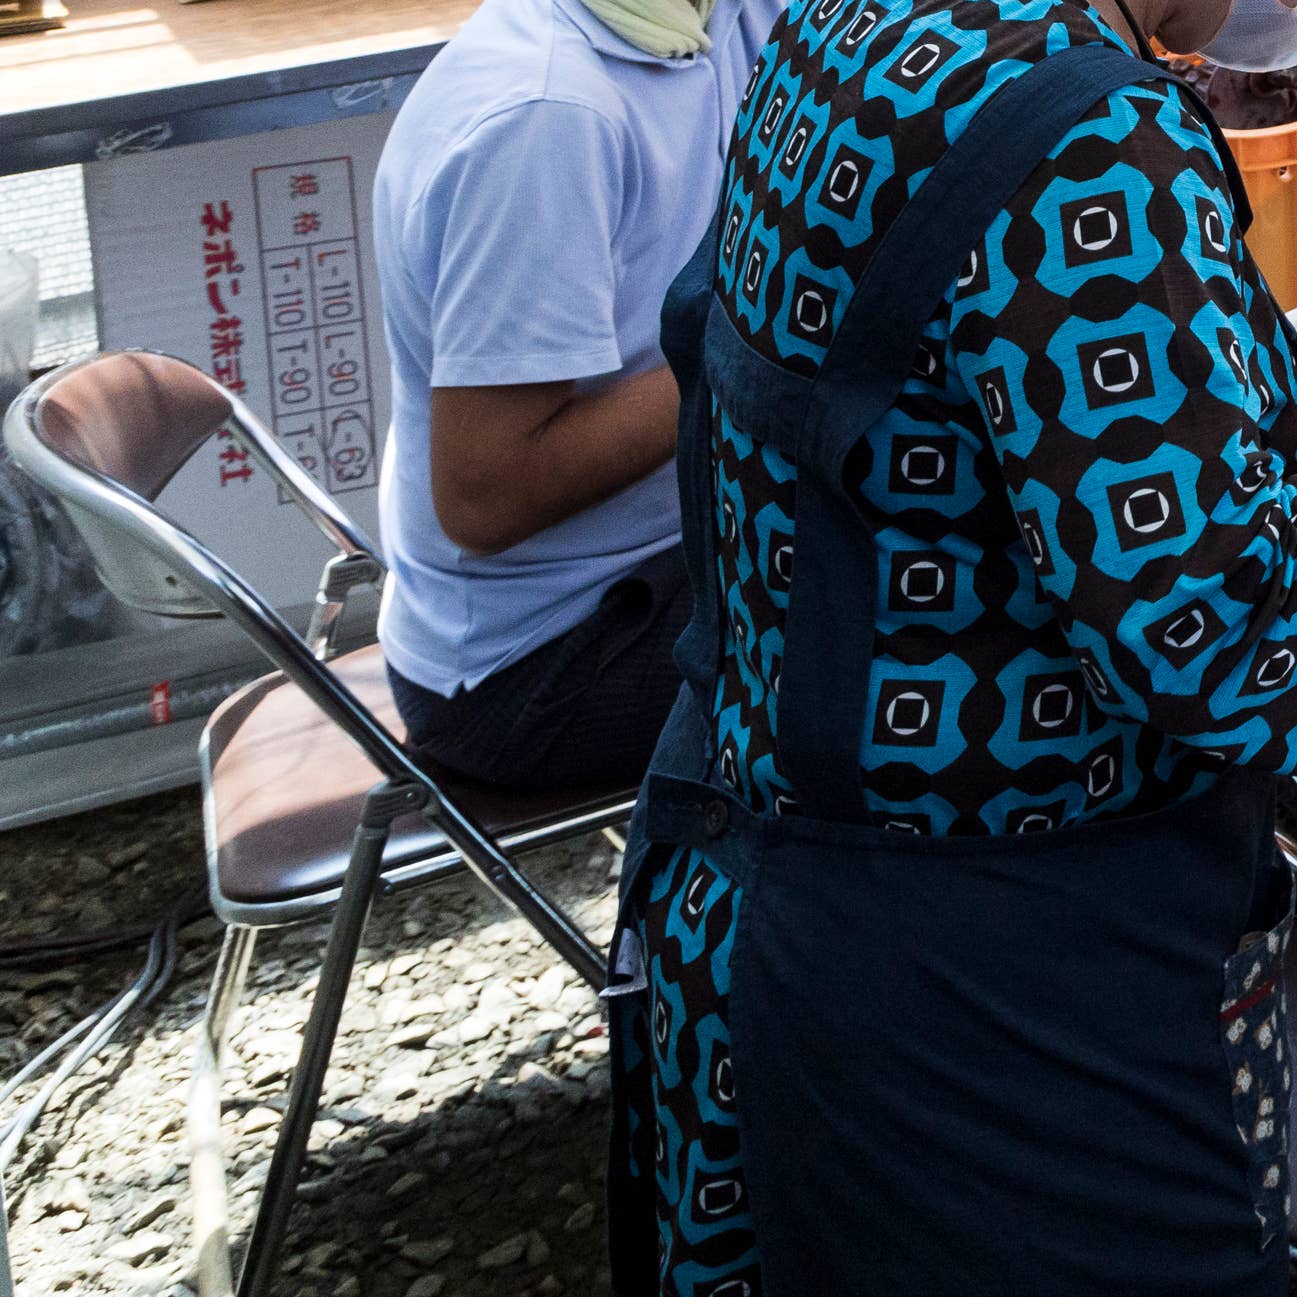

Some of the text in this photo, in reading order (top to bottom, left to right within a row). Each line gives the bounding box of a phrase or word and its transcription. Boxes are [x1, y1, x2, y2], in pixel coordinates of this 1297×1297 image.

[290, 174, 321, 235] 規格
[269, 257, 306, 327] T-110
[317, 250, 353, 319] L-110
[201, 200, 254, 487] ネポン株式社
[277, 338, 312, 404] T-90
[322, 331, 360, 396] L-90
[331, 413, 368, 482] L-63
